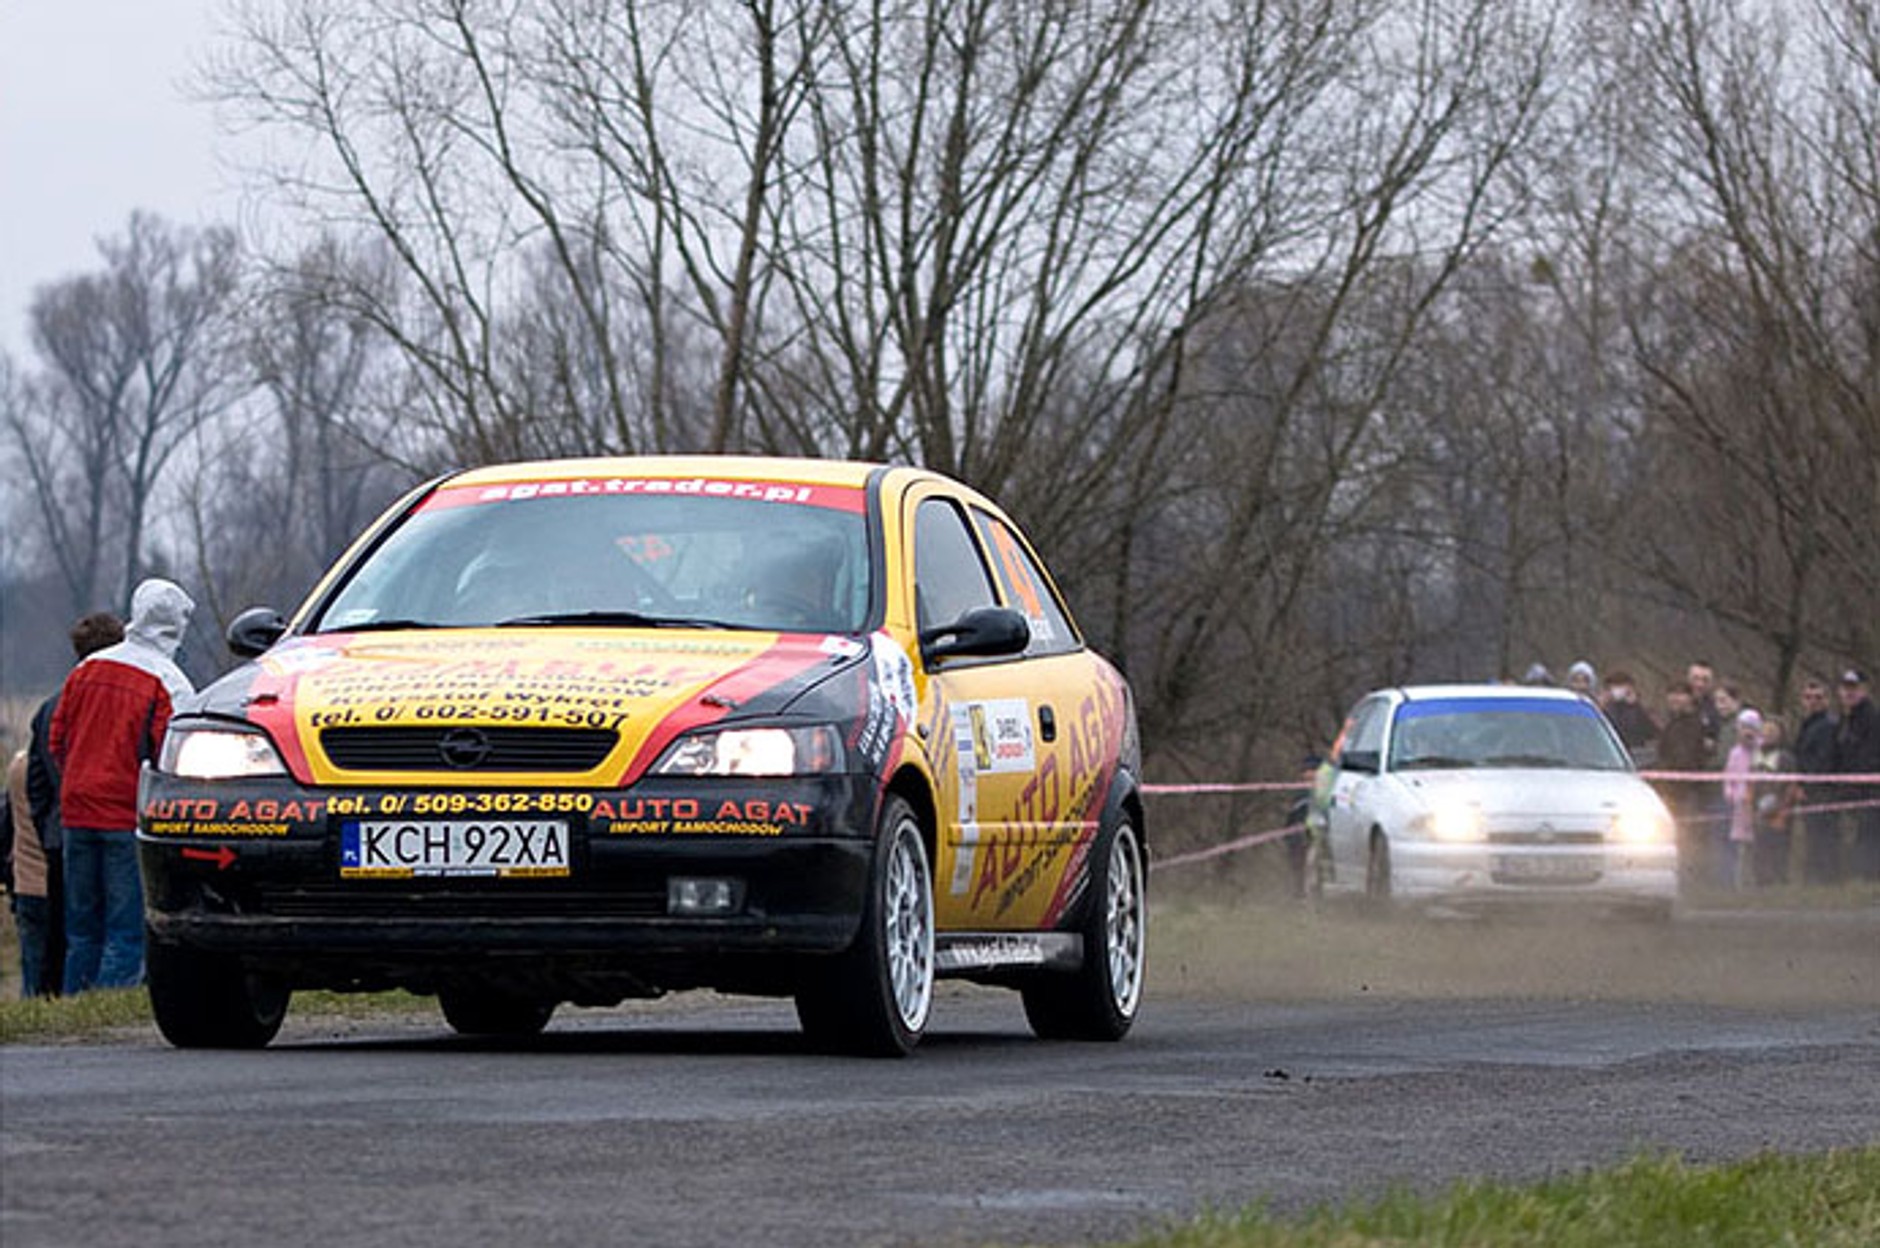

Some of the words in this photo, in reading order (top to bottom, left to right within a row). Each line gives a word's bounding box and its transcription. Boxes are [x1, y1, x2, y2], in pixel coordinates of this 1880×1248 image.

[479, 478, 813, 501] agat.trader.pl
[310, 708, 361, 727] tel.
[375, 705, 407, 721] 0/
[415, 704, 628, 730] 602-591-507
[144, 798, 219, 819] AUTO
[229, 799, 325, 821] AGAT
[326, 794, 371, 814] tel.
[380, 794, 408, 813] 0/
[414, 793, 592, 813] 509-362-850
[589, 799, 699, 819] AUTO
[717, 800, 813, 825] AGAT
[610, 821, 669, 834] IMPORT
[972, 752, 1059, 912] AUTO
[365, 826, 451, 864] KCH
[465, 826, 564, 864] 92XA
